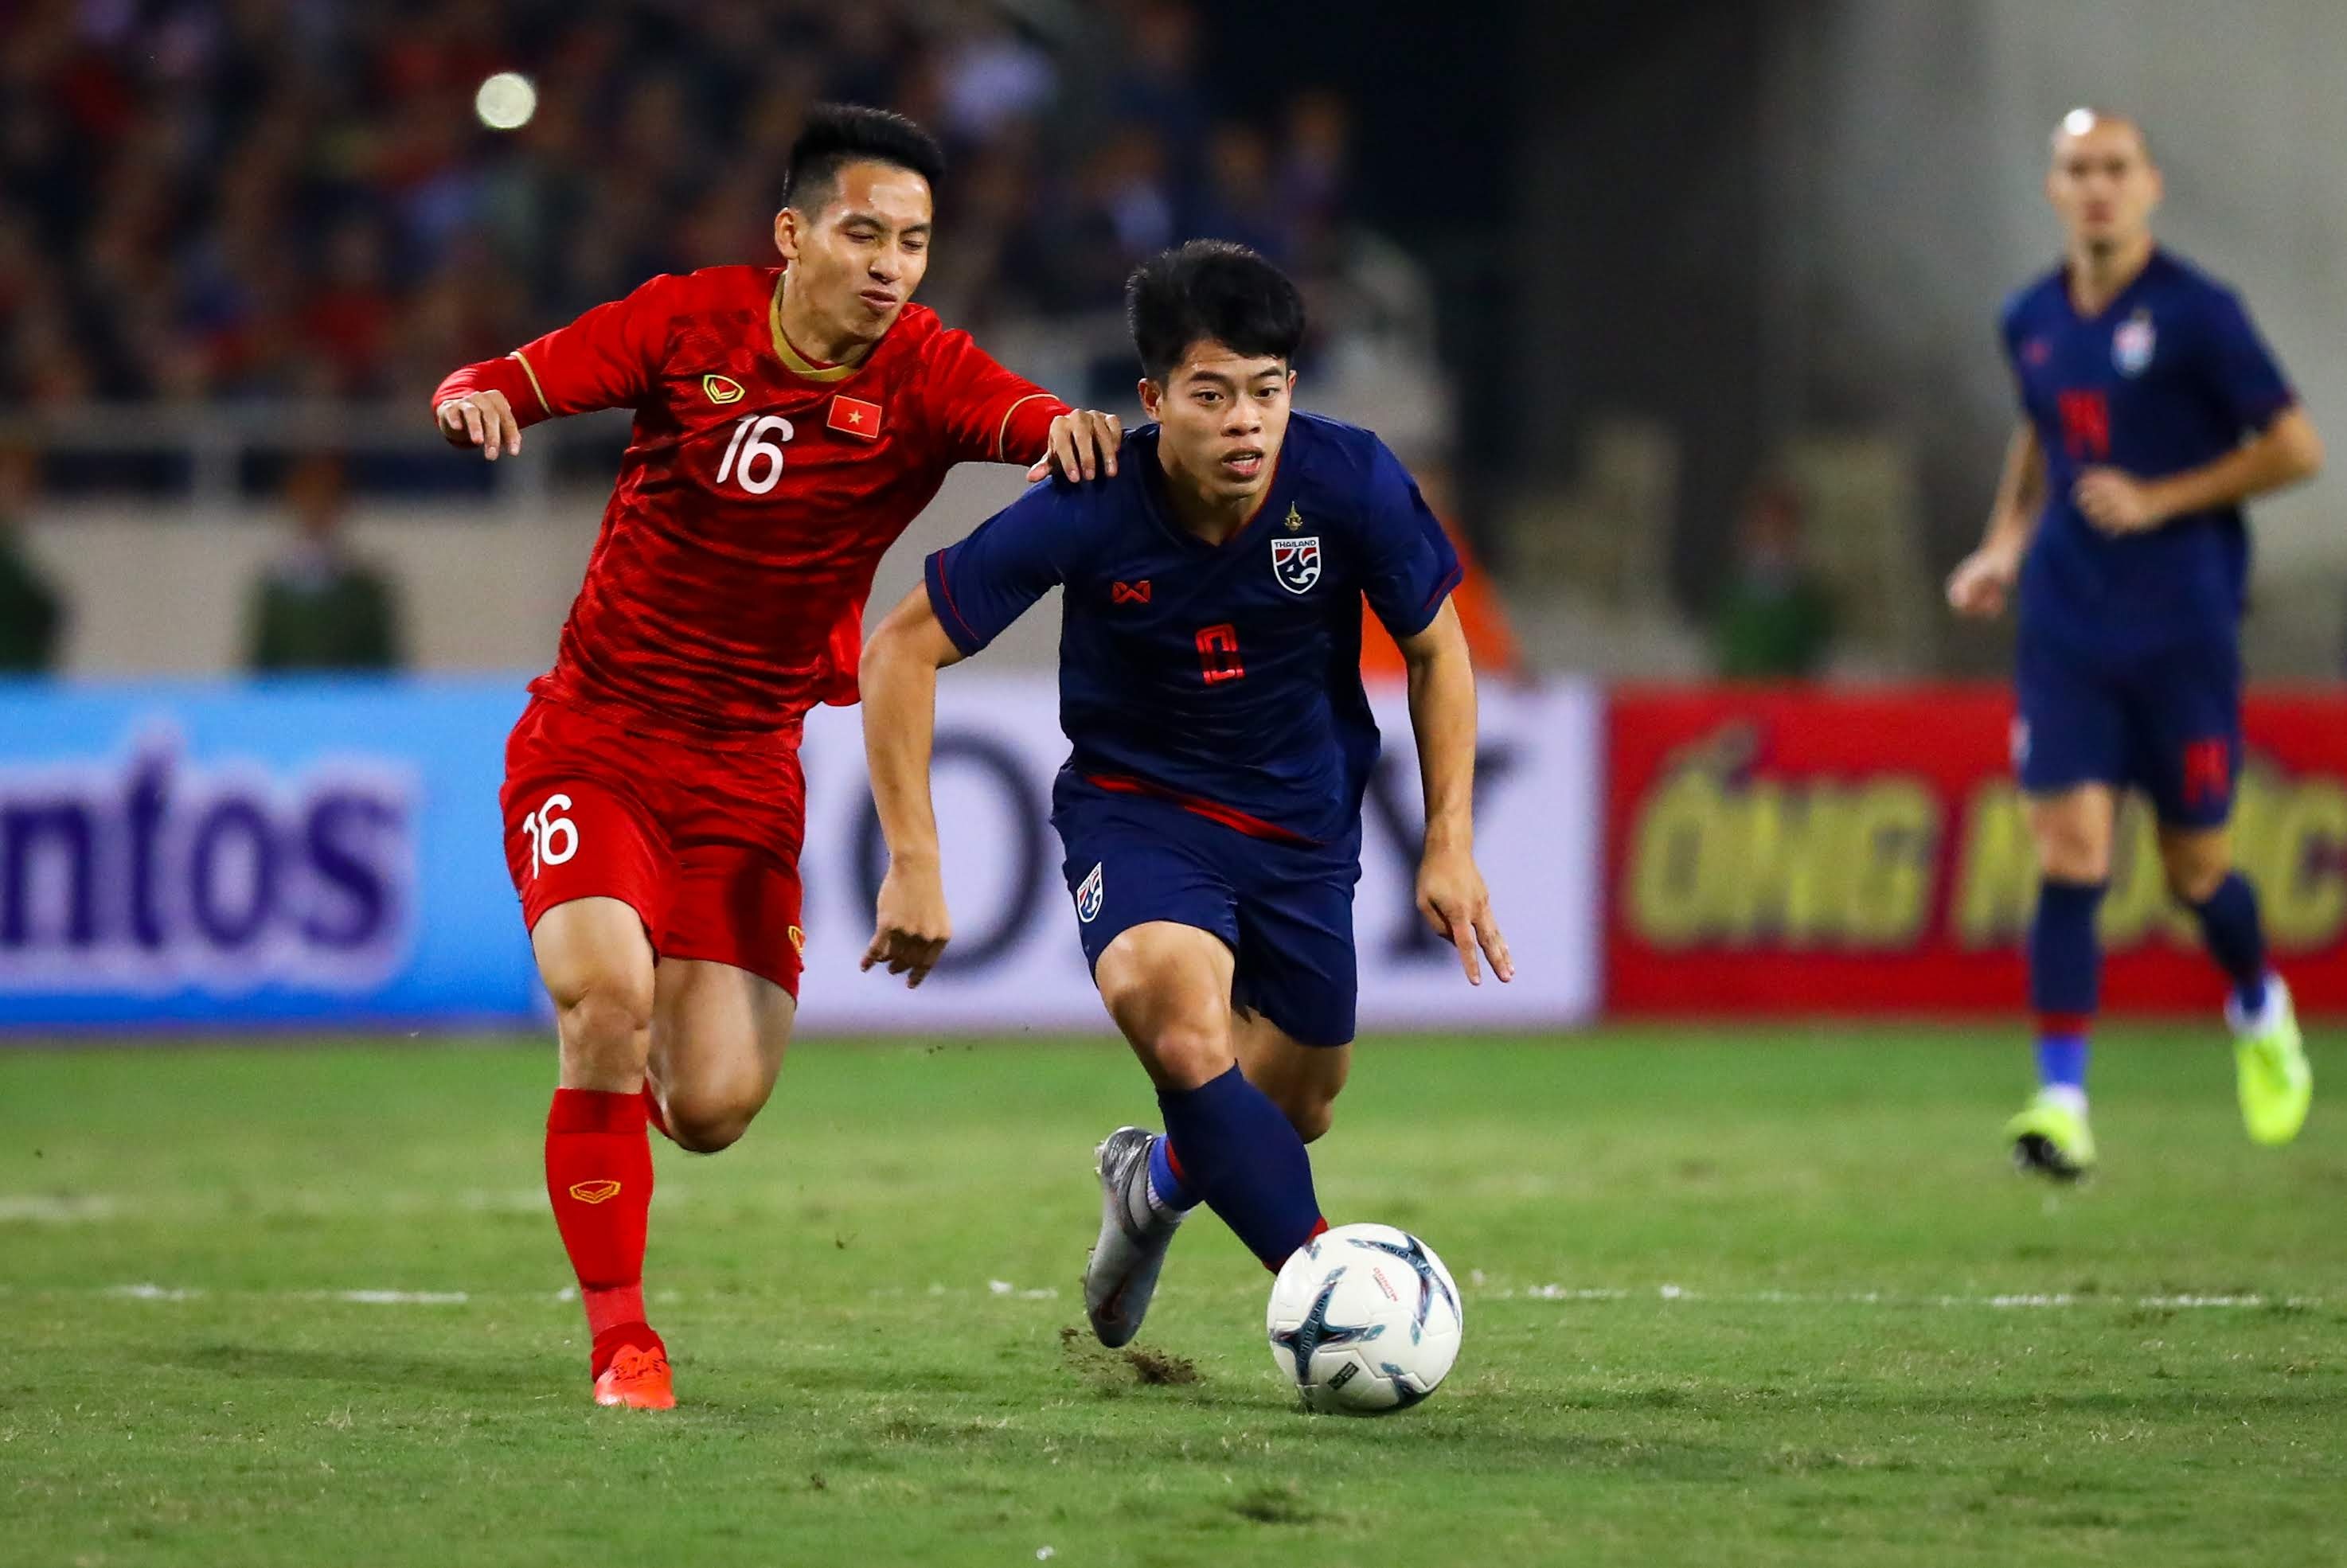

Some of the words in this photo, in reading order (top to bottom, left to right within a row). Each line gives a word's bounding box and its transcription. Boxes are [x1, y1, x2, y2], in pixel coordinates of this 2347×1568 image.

[717, 414, 795, 494] 16
[1274, 540, 1316, 548] THAILAND
[522, 794, 579, 880] 16
